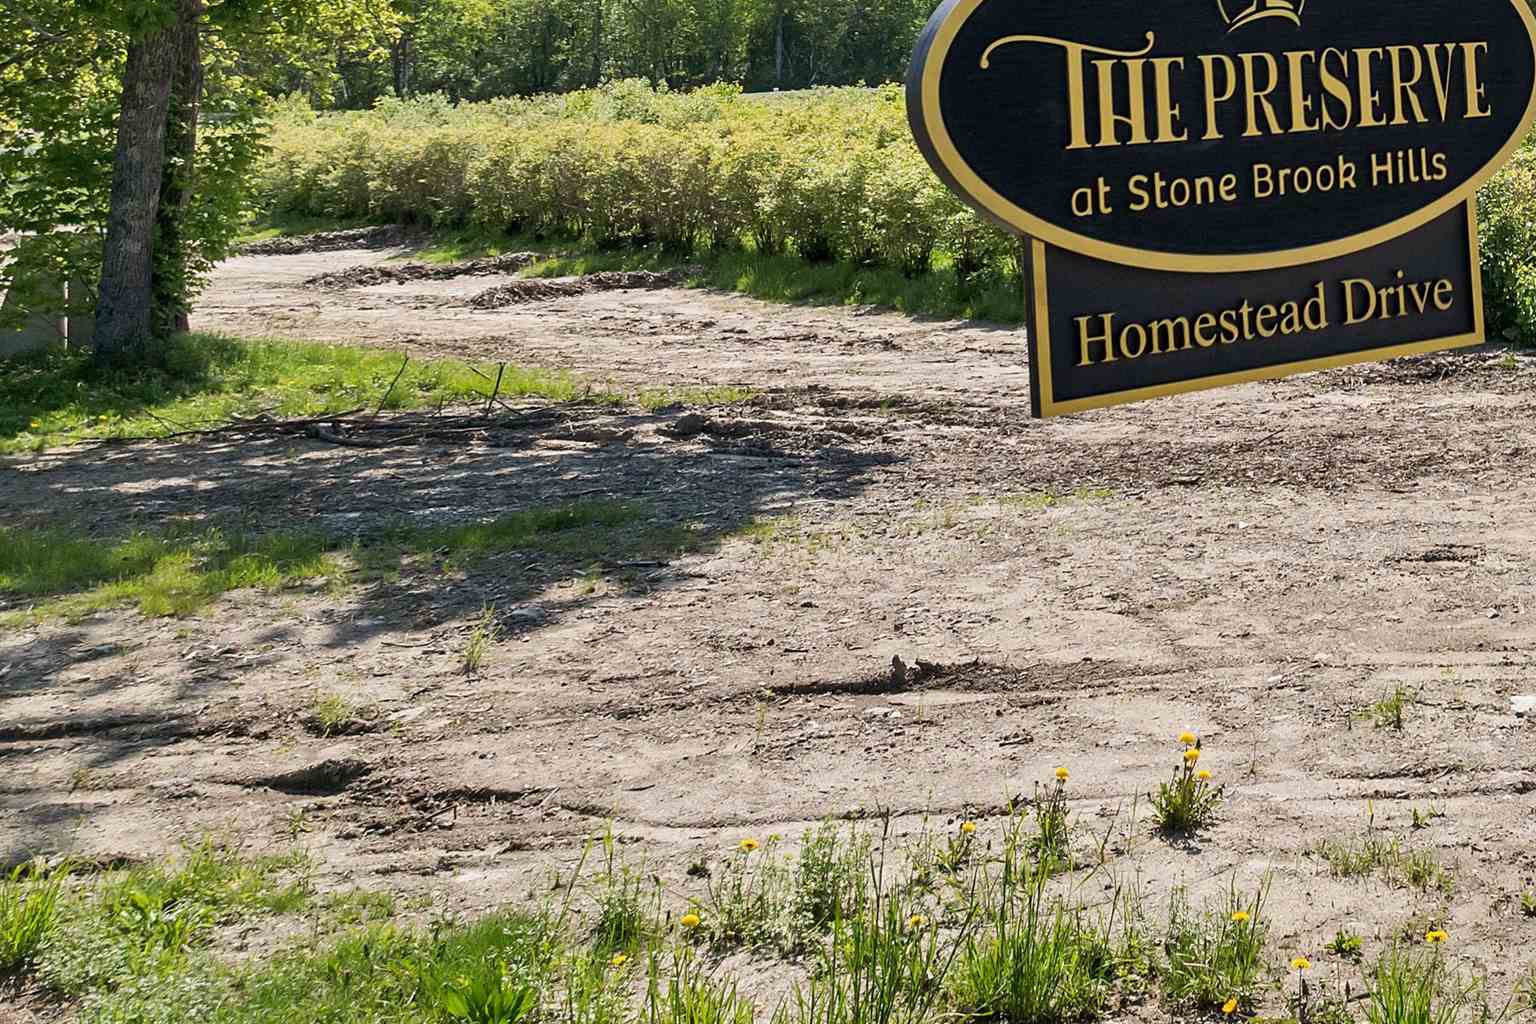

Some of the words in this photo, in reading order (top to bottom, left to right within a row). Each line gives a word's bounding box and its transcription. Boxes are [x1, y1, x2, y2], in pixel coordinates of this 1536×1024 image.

[980, 31, 1188, 150] THE
[1198, 41, 1491, 139] PRESERVE
[1071, 175, 1112, 217] at
[1129, 169, 1237, 212] Stone
[1253, 162, 1357, 199] Brook
[1371, 148, 1448, 187] Hills
[1074, 279, 1329, 366] Homestead
[1343, 271, 1455, 326] Drive
